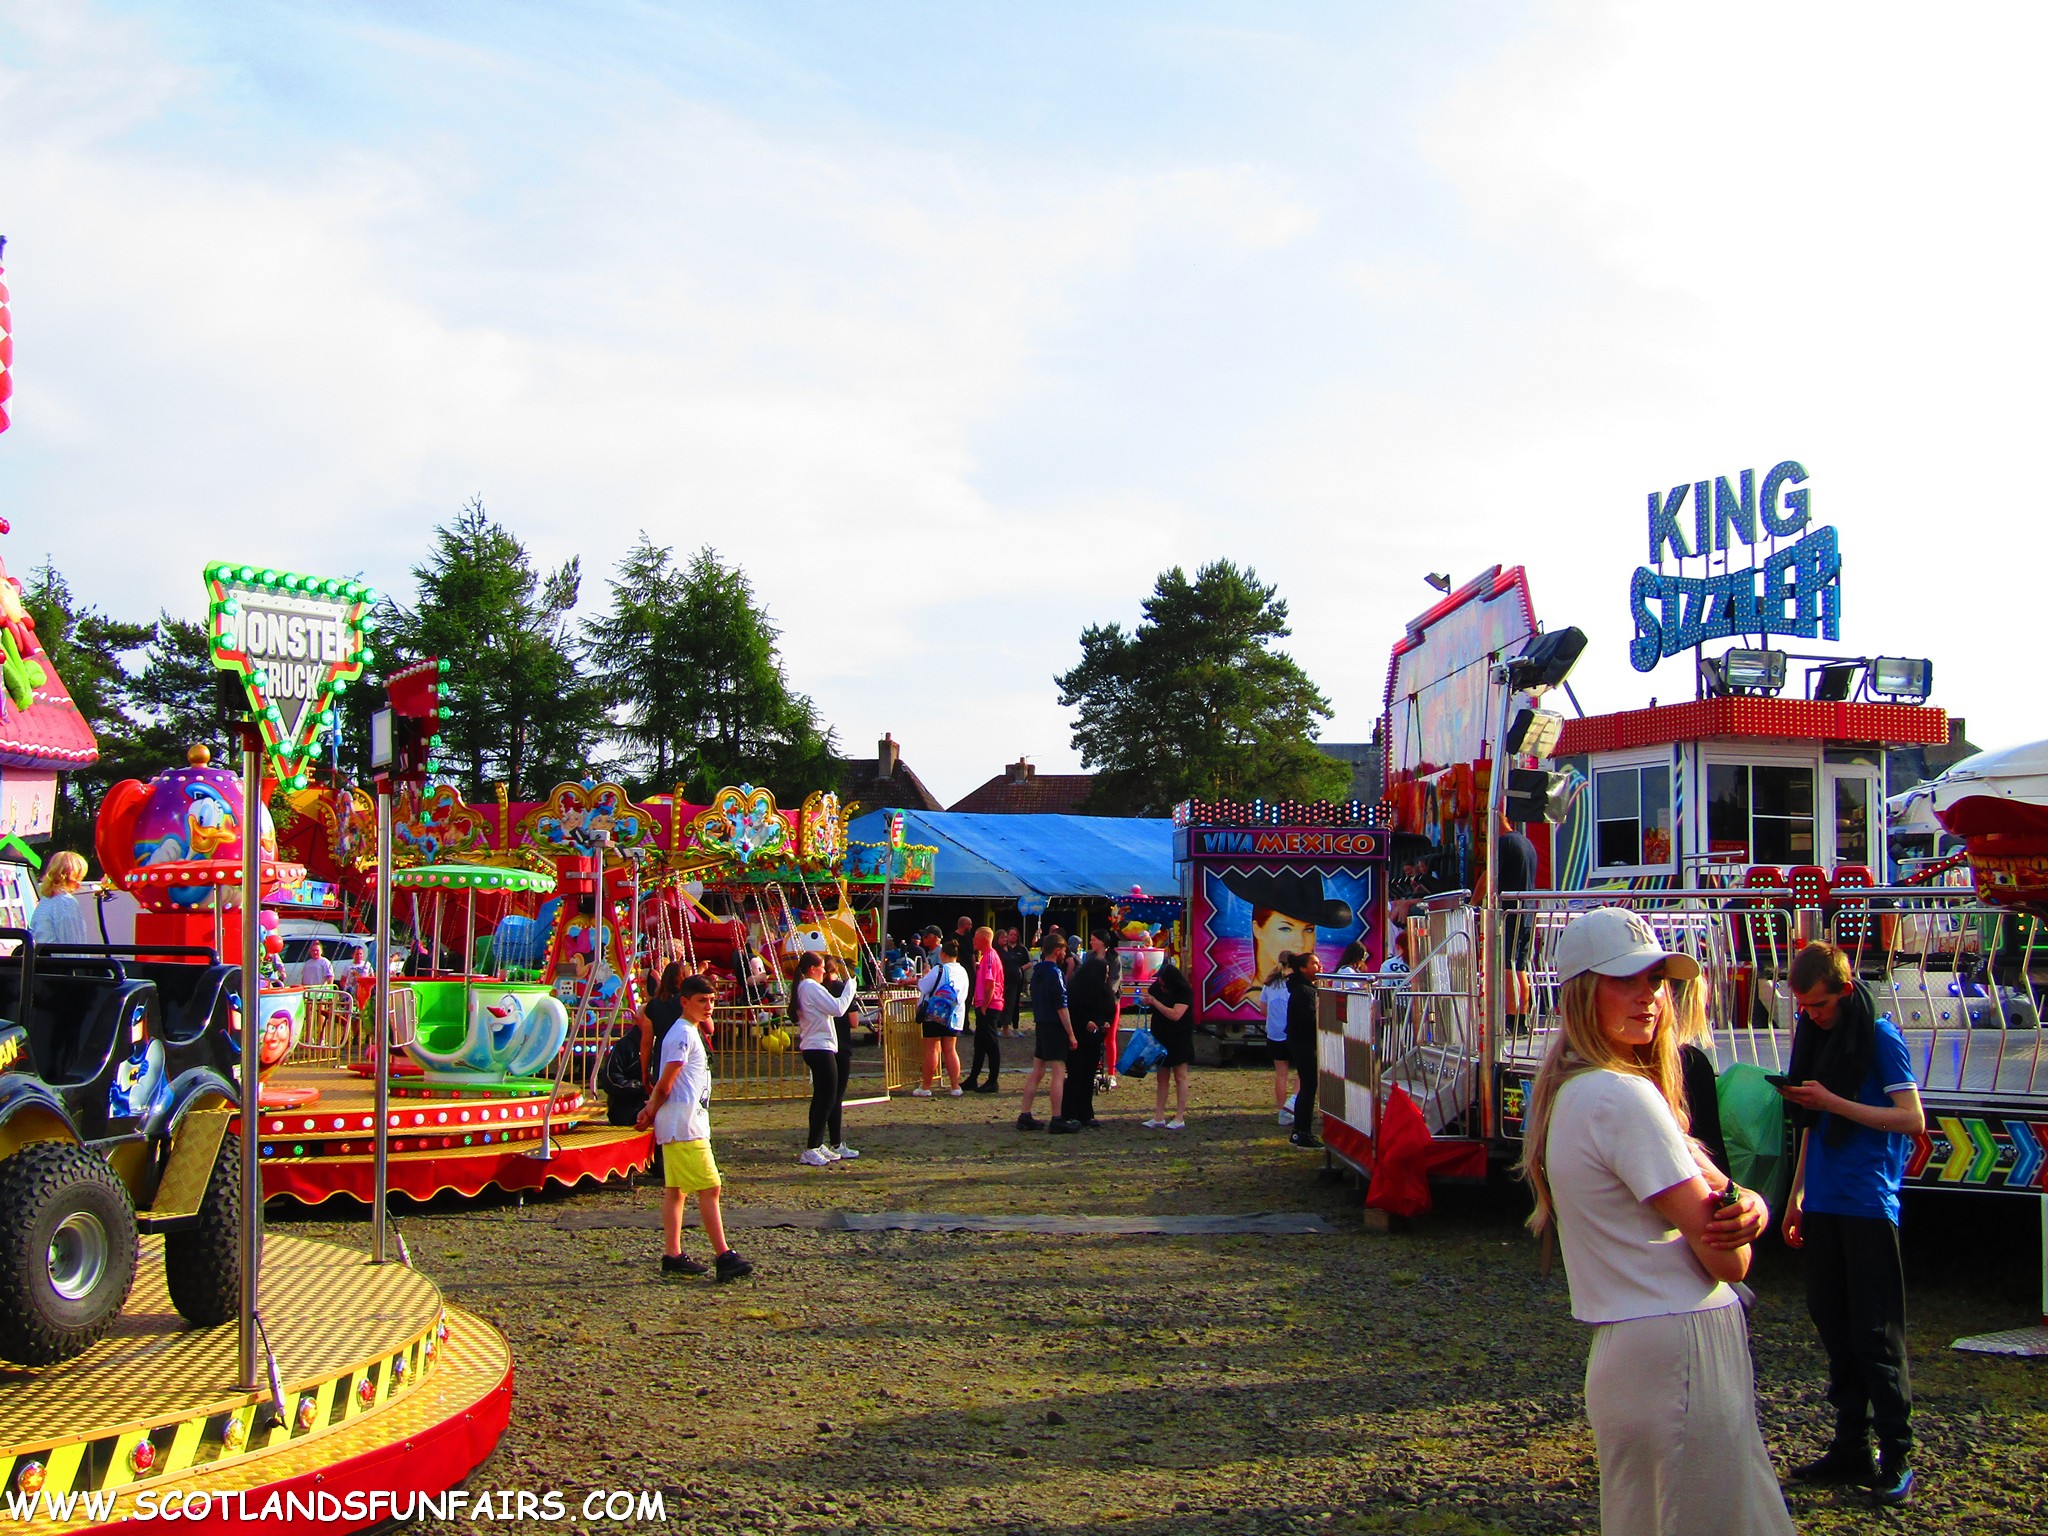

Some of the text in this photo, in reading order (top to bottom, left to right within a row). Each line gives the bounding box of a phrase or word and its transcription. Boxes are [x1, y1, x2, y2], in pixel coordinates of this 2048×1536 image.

[1647, 460, 1812, 564] KING
[1629, 525, 1839, 673] SIZZLER
[220, 608, 355, 664] MONSTER
[254, 659, 320, 701] TRUCK
[1203, 831, 1376, 855] VIVA MEXICO
